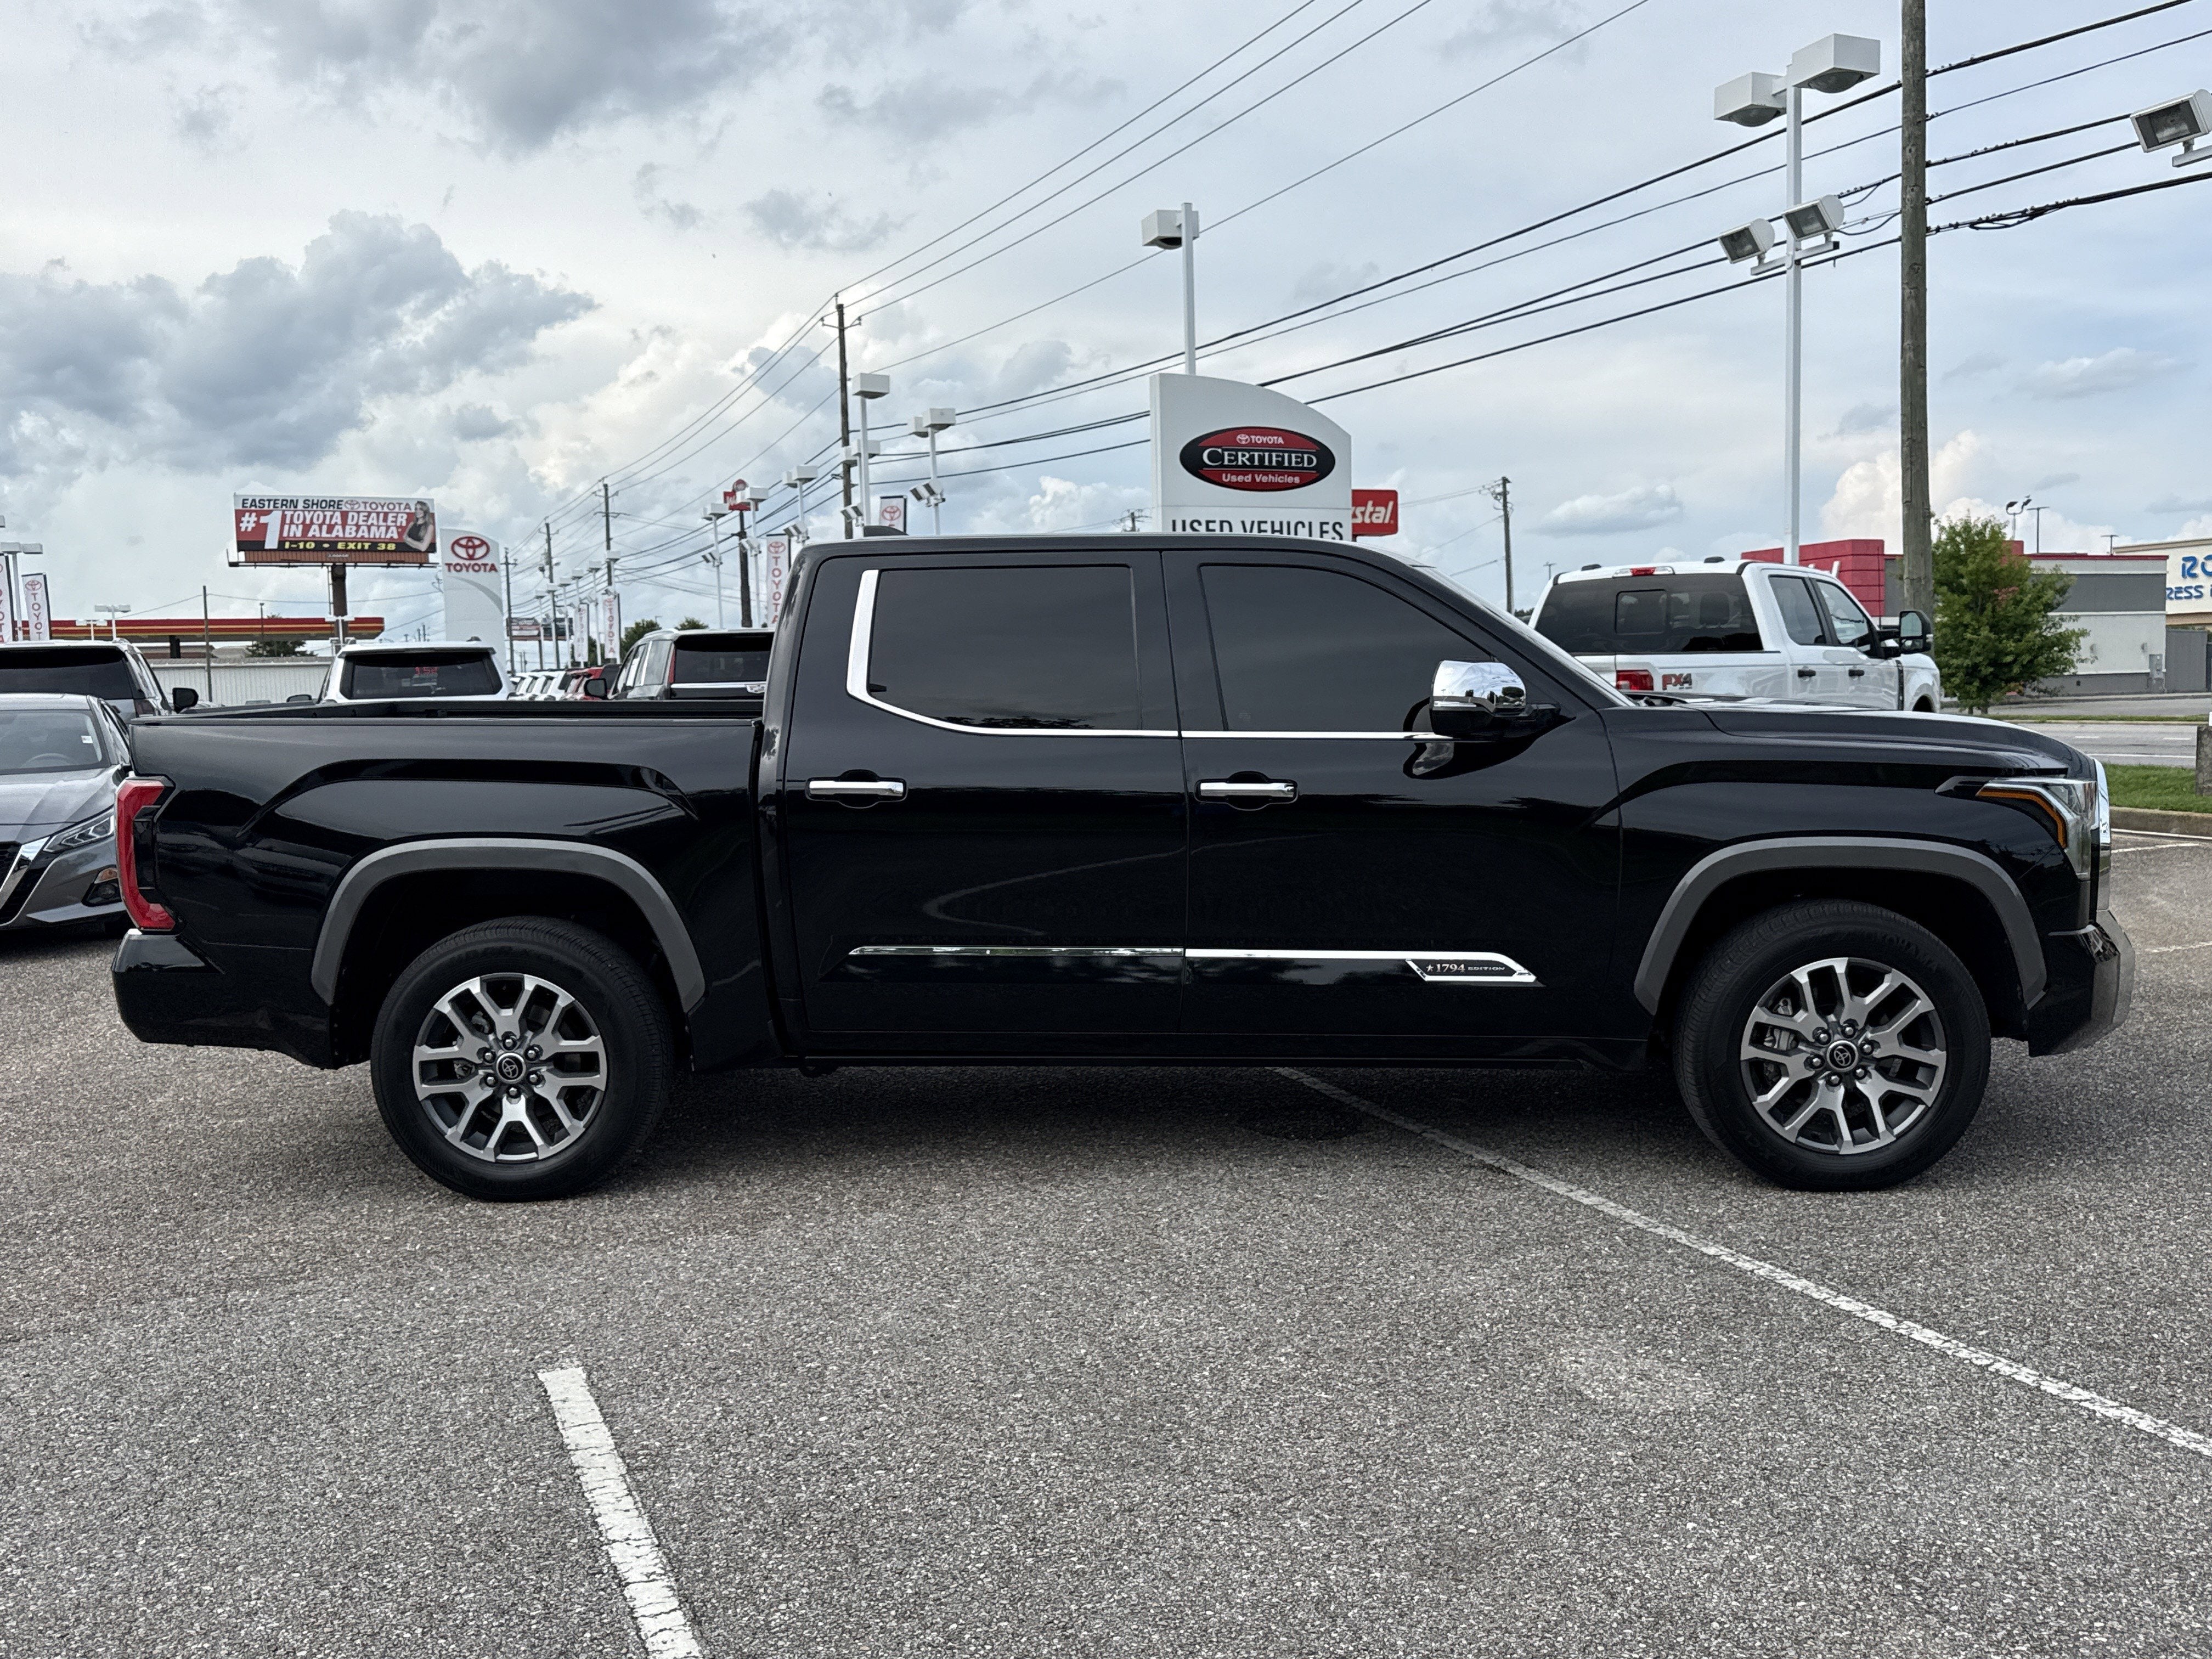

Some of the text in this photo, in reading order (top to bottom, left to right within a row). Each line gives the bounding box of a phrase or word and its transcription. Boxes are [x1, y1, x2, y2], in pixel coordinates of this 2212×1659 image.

[1250, 436, 1284, 445] TOYOTA
[1203, 448, 1317, 467] CERTIFIED
[1222, 473, 1300, 483] Used Vehicles
[241, 498, 411, 511] EASTERN SHORE TOYOTA
[284, 511, 407, 527] TOYOTA DEALER
[283, 524, 303, 538] IN
[1172, 519, 1344, 541] USED VEHICLES
[445, 563, 498, 572] TOYOTA
[31, 592, 43, 641] TOYOT
[605, 607, 615, 653] TOYOTA
[1662, 673, 1692, 690] FX4
[1436, 963, 1465, 973] 1794
